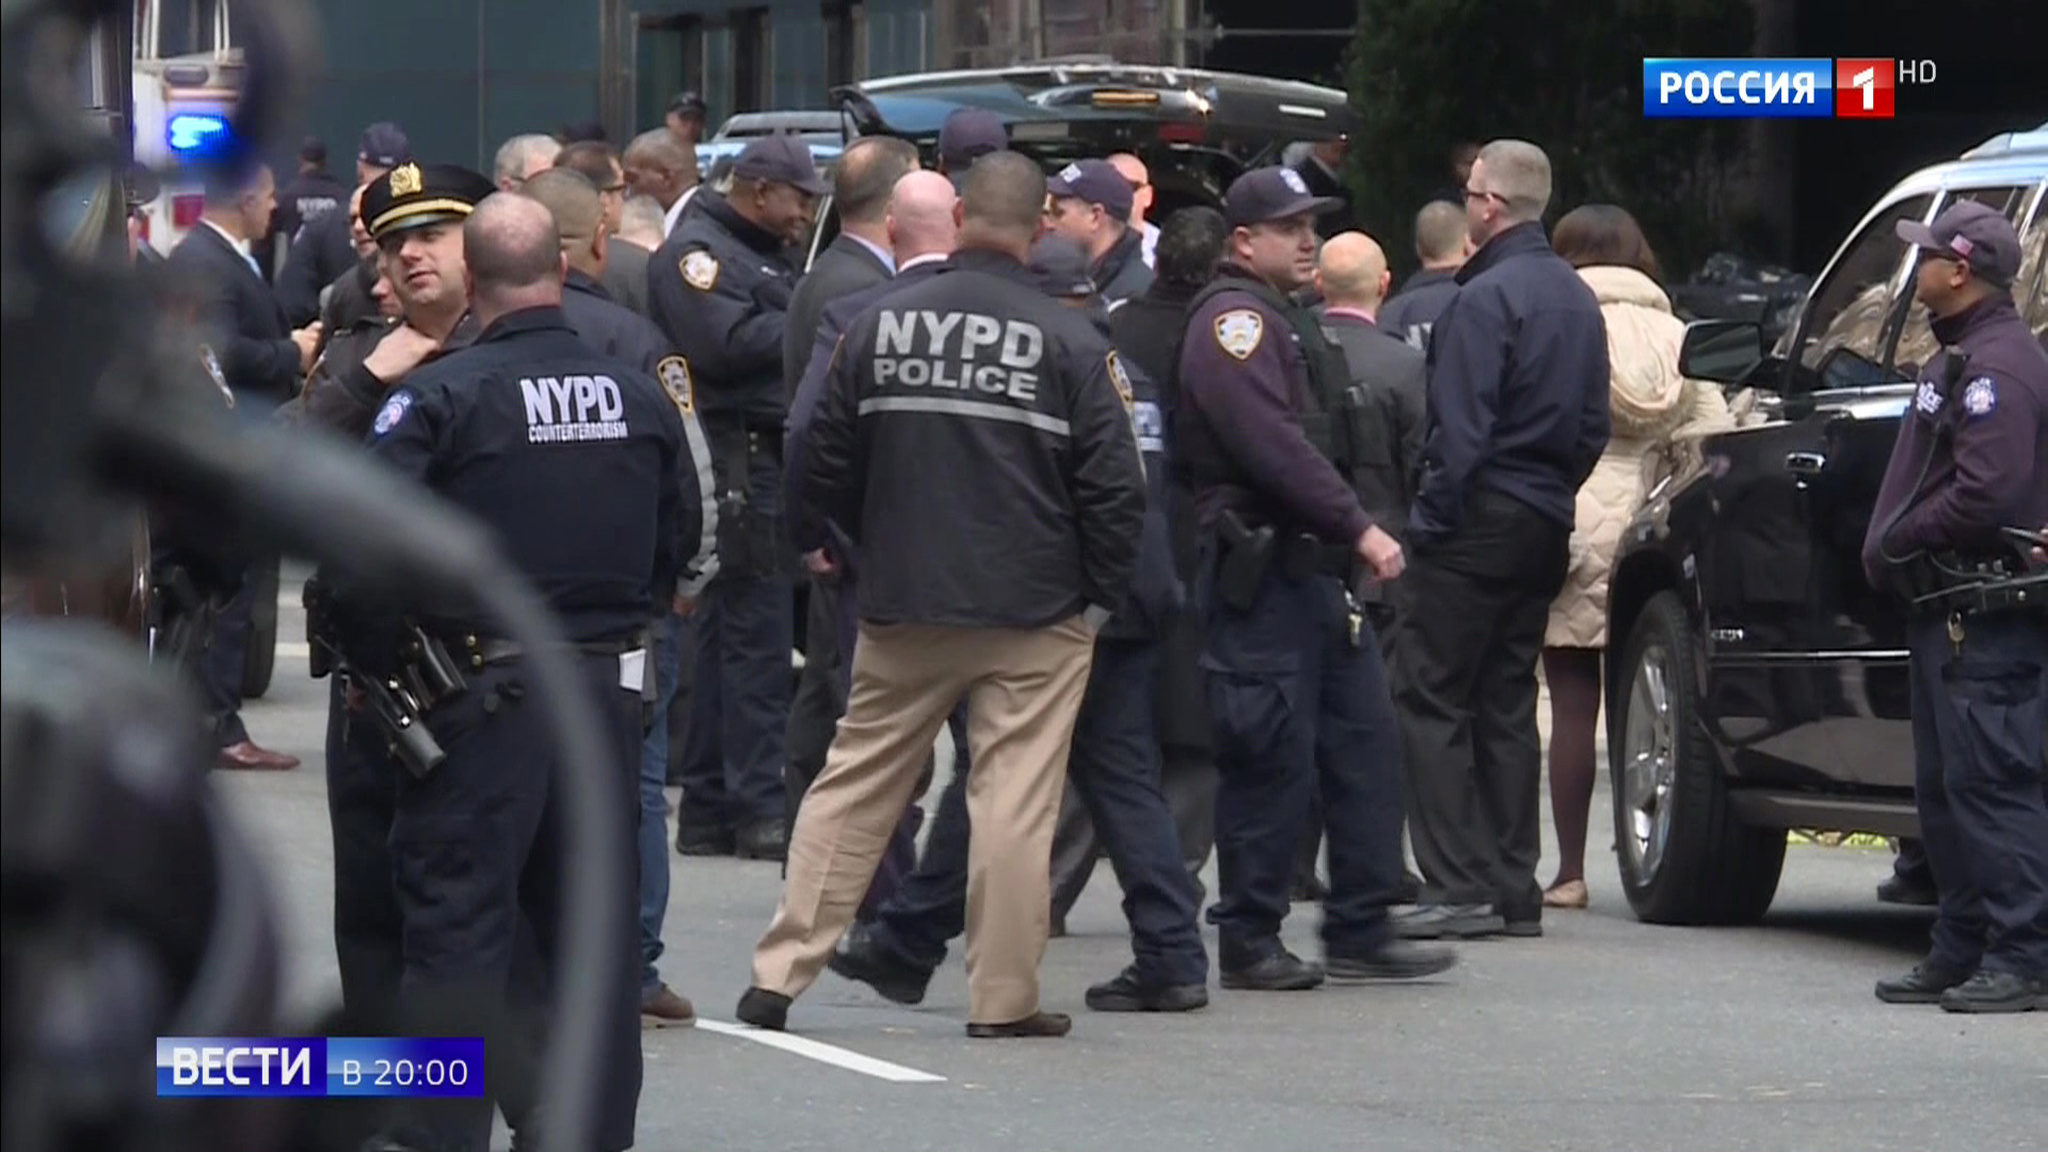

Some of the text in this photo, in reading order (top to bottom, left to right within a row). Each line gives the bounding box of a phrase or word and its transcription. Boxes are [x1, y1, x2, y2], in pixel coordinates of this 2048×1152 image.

[874, 310, 1044, 369] NYPD
[520, 375, 624, 425] NYPD
[873, 358, 1039, 401] POLICE
[528, 421, 629, 443] COUNTERTERRORISM
